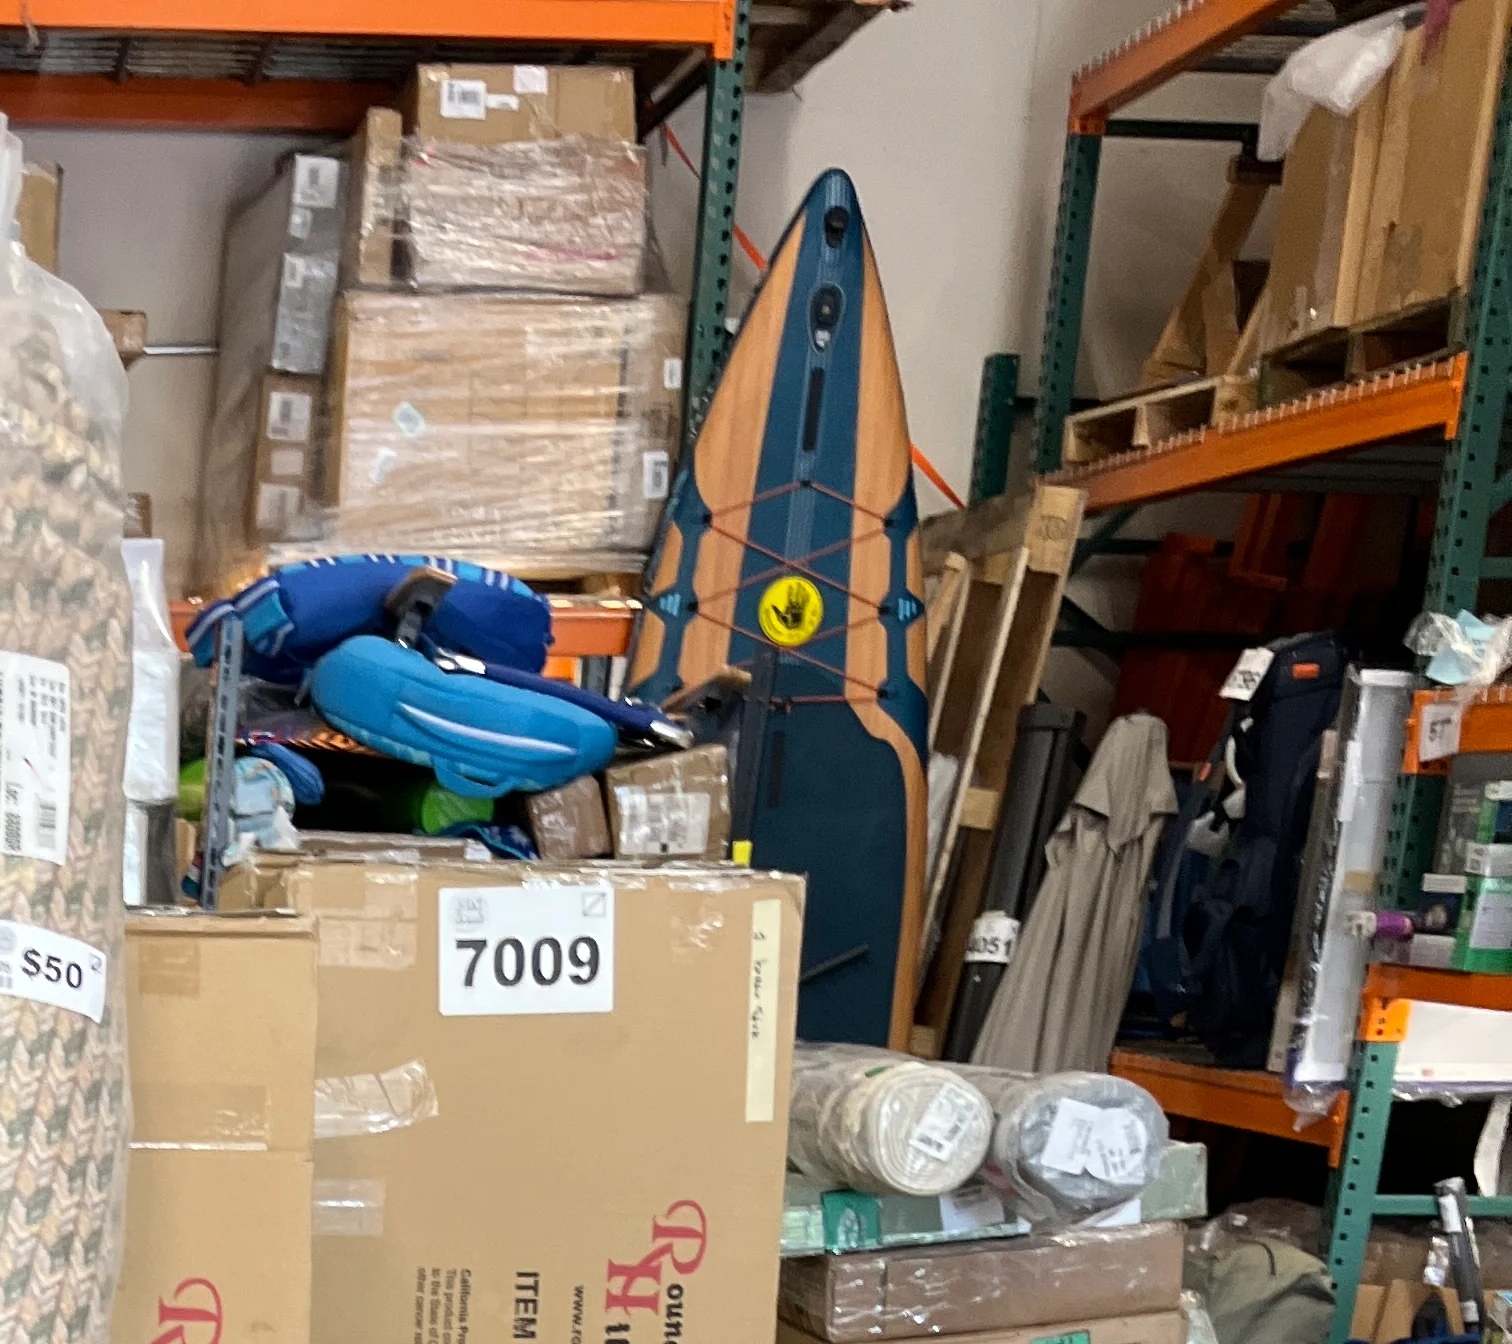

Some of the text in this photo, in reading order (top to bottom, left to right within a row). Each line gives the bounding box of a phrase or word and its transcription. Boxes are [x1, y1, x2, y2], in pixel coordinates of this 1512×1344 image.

[21, 948, 83, 989] $50
[455, 936, 600, 987] 7009
[458, 1267, 472, 1326] California
[513, 1272, 539, 1338] ITEM
